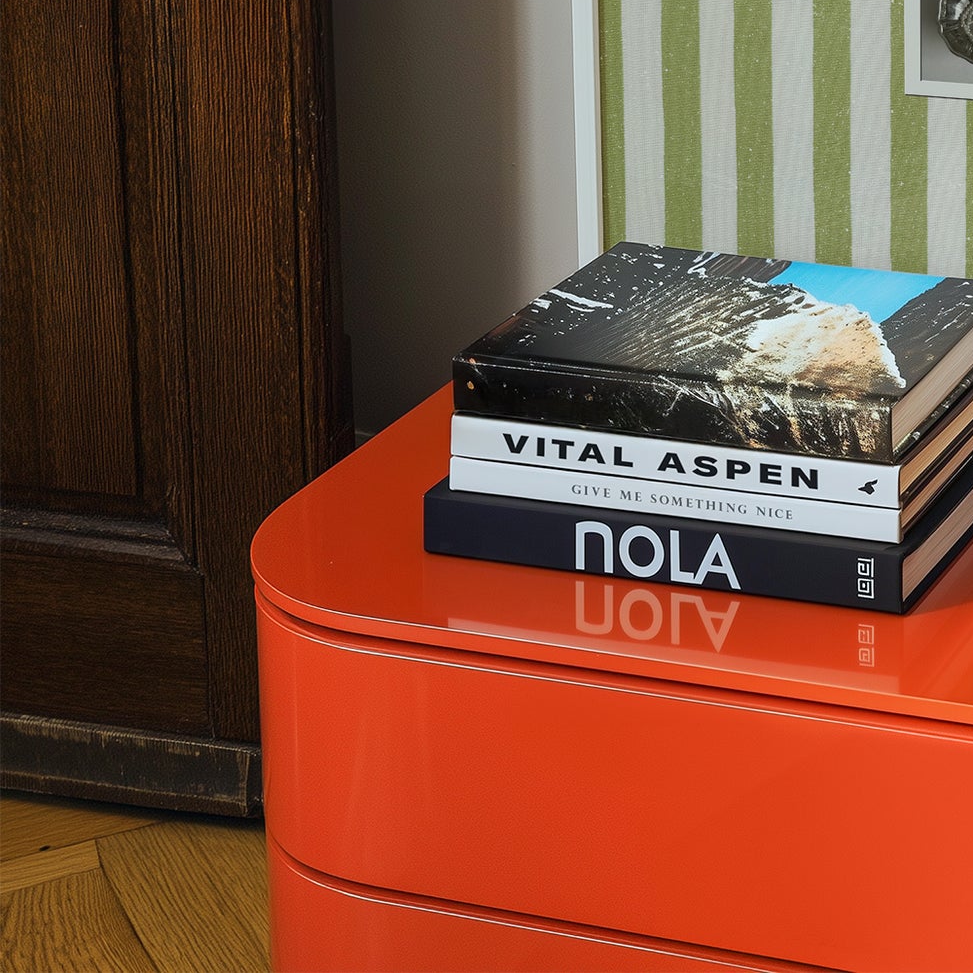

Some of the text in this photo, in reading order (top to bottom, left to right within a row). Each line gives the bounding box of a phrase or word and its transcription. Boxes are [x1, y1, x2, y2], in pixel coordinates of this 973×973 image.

[502, 432, 819, 490] VITAL ASPEN
[571, 483, 793, 520] GIVE ME SOMETHING NICE
[575, 520, 742, 590] NOLA
